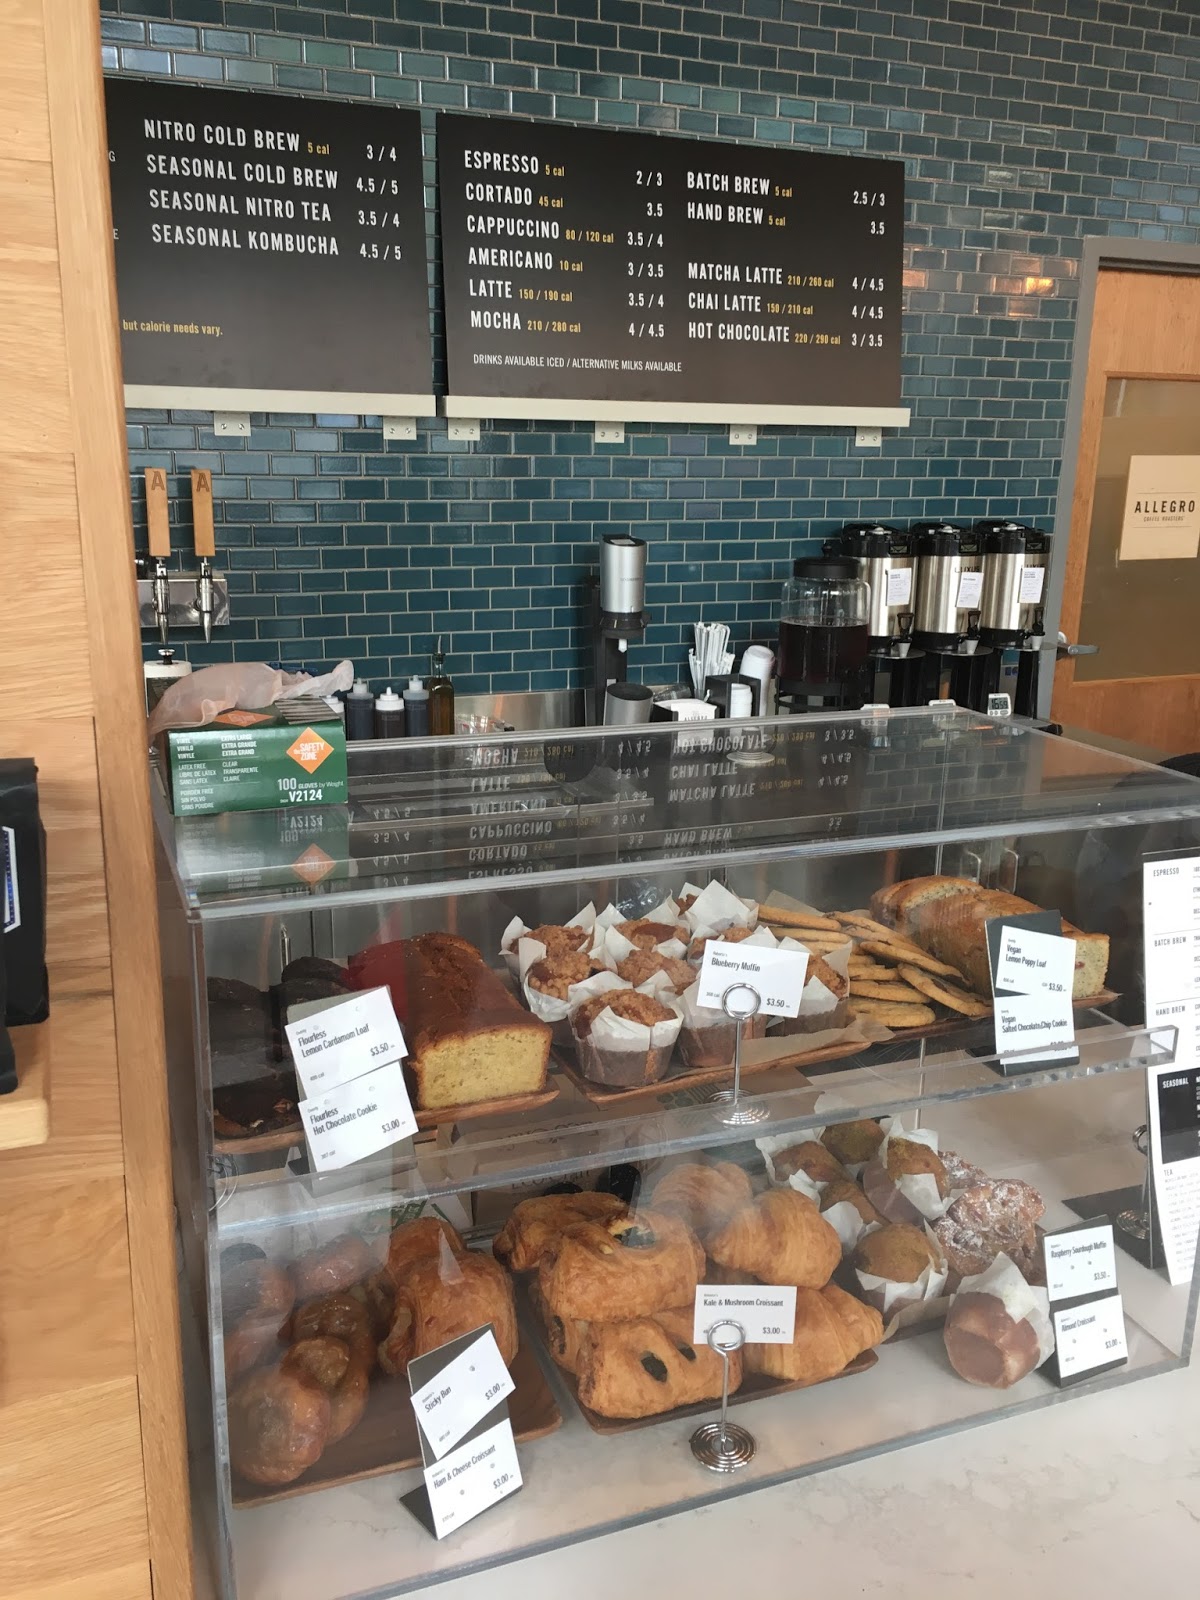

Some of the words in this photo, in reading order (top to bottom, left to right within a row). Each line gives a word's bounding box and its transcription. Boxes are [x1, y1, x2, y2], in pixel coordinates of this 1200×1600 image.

[145, 119, 195, 142] NITRO
[204, 125, 246, 147] COLD
[255, 129, 299, 152] BREW
[308, 142, 313, 153] 5
[316, 144, 330, 155] cal
[366, 145, 373, 160] 3
[390, 147, 396, 162] 4
[147, 154, 236, 180] SEASONAL
[244, 163, 285, 185] COLD
[293, 167, 338, 189] BREW
[356, 177, 375, 193] 4.5
[392, 180, 398, 195] 5
[465, 150, 539, 174] ESPRESSO
[545, 165, 550, 176] 5
[553, 166, 565, 176] cal
[636, 170, 642, 185] 2
[657, 172, 663, 186] 3
[687, 171, 729, 192] BATCH
[735, 176, 770, 196] BREW
[775, 186, 779, 196] 5
[782, 187, 792, 197] cal
[853, 191, 867, 205] 2.5
[880, 193, 885, 206] 3
[150, 188, 239, 214] SEASONAL
[246, 197, 294, 219] NITRO
[301, 201, 332, 222] TEA
[358, 210, 376, 226] 3.5
[392, 212, 400, 228] 4
[466, 183, 532, 205] CORTADO
[539, 196, 549, 207] 45
[551, 197, 563, 208] cal
[647, 203, 663, 217] 3.5
[688, 202, 722, 221] HAND
[728, 206, 763, 224] BREW
[769, 215, 773, 225] 5
[776, 216, 786, 226] cal
[870, 221, 884, 234] 3.5
[467, 215, 560, 239] CAPPUCCINO
[566, 230, 576, 241] 80
[586, 230, 600, 242] 120
[602, 232, 614, 243] cal
[628, 232, 644, 246] 3.5
[657, 233, 663, 247] 4
[152, 224, 241, 248] SEASONAL
[248, 231, 339, 255] KOMBUCHA
[360, 243, 378, 259] 4.5
[395, 245, 402, 260] 5
[468, 247, 553, 270] AMERICANO
[560, 260, 569, 271] 10
[571, 261, 583, 272] cal
[628, 263, 634, 276] 3
[648, 263, 664, 278] 3.5
[688, 262, 740, 282] MATCHA
[746, 266, 783, 284] LATTE
[788, 275, 800, 286] 210
[824, 278, 834, 288] cal
[852, 277, 858, 290] 4
[870, 278, 884, 291] 4.5
[470, 279, 512, 298] LATTE
[519, 289, 534, 300] 150
[544, 290, 558, 301] 190
[561, 291, 573, 302] cal
[628, 293, 644, 307] 3.5
[658, 294, 664, 308] 4
[688, 292, 718, 310] CHAI
[724, 294, 761, 312] LATTE
[767, 303, 779, 313] 150
[788, 304, 800, 314] 210
[803, 305, 813, 315] cal
[852, 305, 857, 318] 4
[869, 306, 883, 319] 4.5
[123, 319, 138, 331] but
[140, 321, 171, 333] calorie
[173, 322, 199, 334] needs
[202, 324, 223, 336] vary.
[470, 310, 521, 330] MOCHA
[527, 320, 542, 331] 210
[552, 322, 566, 332] 280
[569, 322, 581, 333] cal
[629, 323, 634, 336] 4
[648, 324, 664, 337] 4.5
[689, 322, 713, 338] HOT
[718, 323, 789, 342] CHOCOLATE
[795, 334, 808, 343] 220
[831, 336, 840, 345] cal
[852, 334, 857, 346] 3
[869, 334, 883, 347] 3.5
[474, 354, 503, 365] DRINKS
[505, 355, 544, 367] AVAILABLE
[547, 356, 564, 367] ICED
[572, 358, 619, 370] ALTERNATIVE
[622, 360, 643, 370] MILKS
[645, 361, 682, 372] AVAILABLE
[1134, 500, 1195, 513] ALLEGRO
[300, 742, 325, 751] SAFETY
[300, 752, 317, 761] ZONE
[278, 778, 296, 791] 100
[289, 789, 323, 802] V2124
[1153, 867, 1180, 877] ESPRESSO
[1007, 944, 1021, 955] Vegan
[1154, 938, 1171, 947] BATCH
[1172, 936, 1187, 945] BREW
[712, 957, 740, 971] Blueberry
[741, 962, 760, 972] Muffin
[1006, 954, 1021, 964] Lemon
[1022, 957, 1035, 968] Poppy
[1036, 959, 1046, 968] Loaf
[1049, 982, 1062, 992] $3.50
[766, 998, 785, 1008] $3.50
[1001, 1015, 1016, 1025] Vegan
[1002, 1023, 1017, 1033] Salted
[298, 1030, 327, 1046] Flourless
[301, 1044, 323, 1058] Lemon
[323, 1030, 356, 1050] Cardamom
[355, 1023, 370, 1036] Loaf
[370, 1042, 389, 1057] $3.50
[1163, 1077, 1189, 1089] SEASONAL
[310, 1107, 339, 1124] Flourless
[313, 1125, 325, 1136] Hot
[325, 1113, 356, 1130] Chocolate
[356, 1102, 378, 1117] Cookie
[382, 1119, 400, 1133] $3.00
[1051, 1247, 1072, 1259] Raspberry
[1094, 1271, 1106, 1280] $3.50
[724, 1298, 754, 1306] Mushroom
[1105, 1338, 1118, 1349] $3.00
[424, 1394, 442, 1413] Sticky
[440, 1386, 452, 1398] Bun
[484, 1382, 501, 1401] $3.00
[433, 1475, 447, 1490] Ham
[446, 1472, 452, 1481] &
[451, 1460, 472, 1478] Cheese
[471, 1444, 496, 1467] Croissant
[493, 1473, 509, 1490] $3.00
